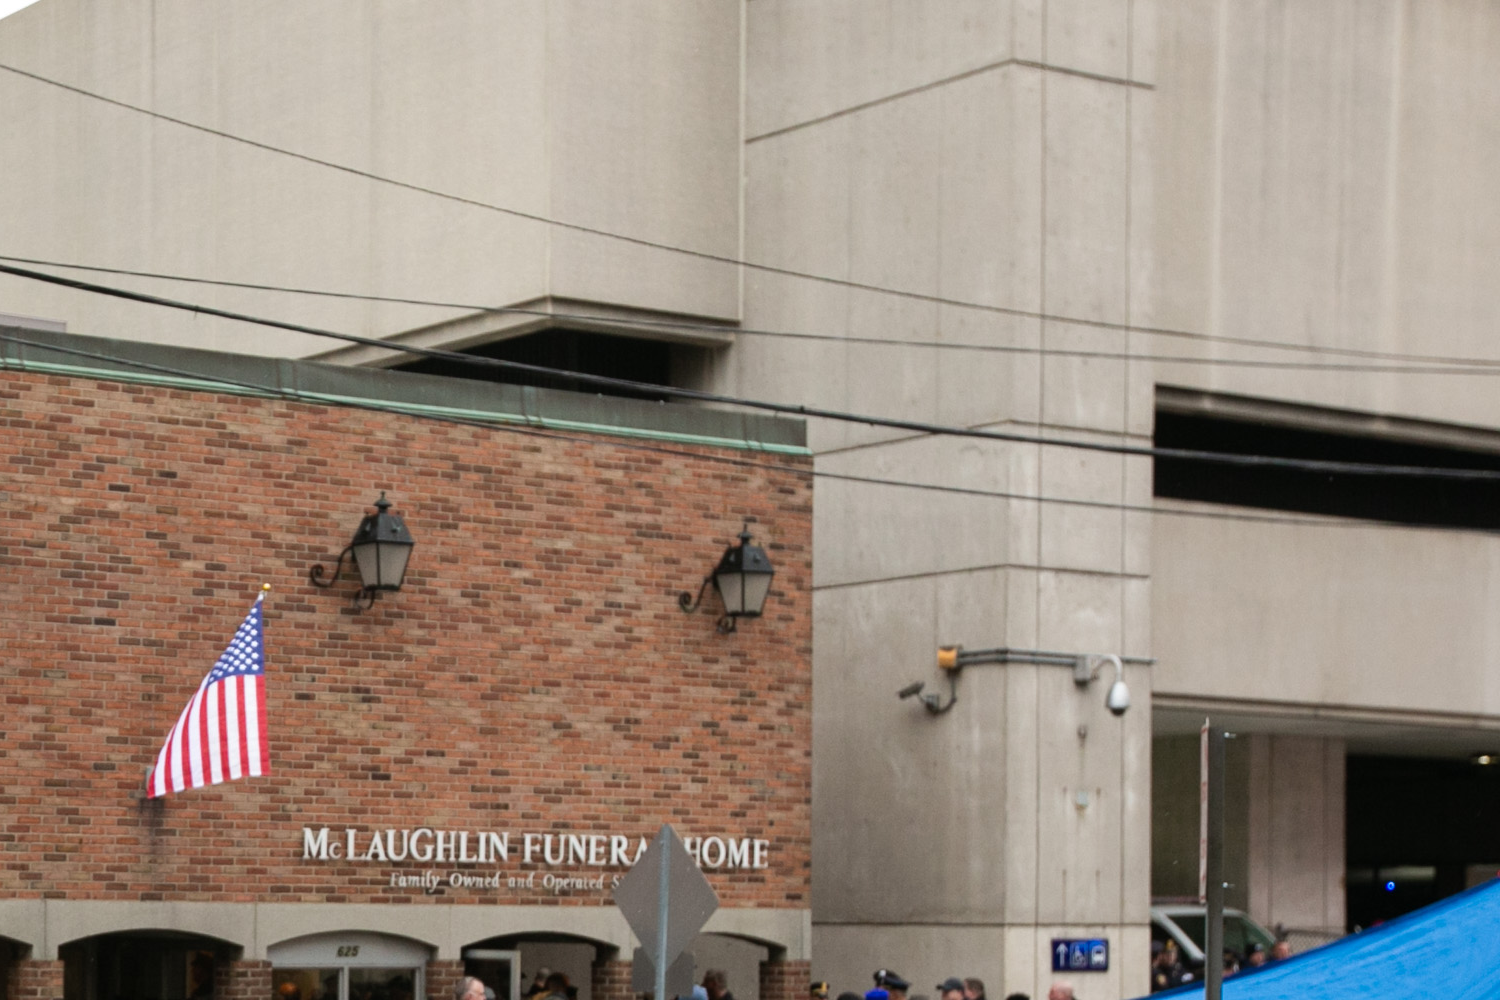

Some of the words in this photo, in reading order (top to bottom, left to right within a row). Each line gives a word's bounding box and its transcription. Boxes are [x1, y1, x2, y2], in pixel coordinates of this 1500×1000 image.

[522, 832, 648, 867] FUNERA
[683, 836, 770, 869] HOME
[390, 870, 440, 895] Family
[450, 871, 501, 889] Owned
[508, 871, 534, 889] and
[543, 873, 604, 894] Operated
[336, 945, 360, 958] 625
